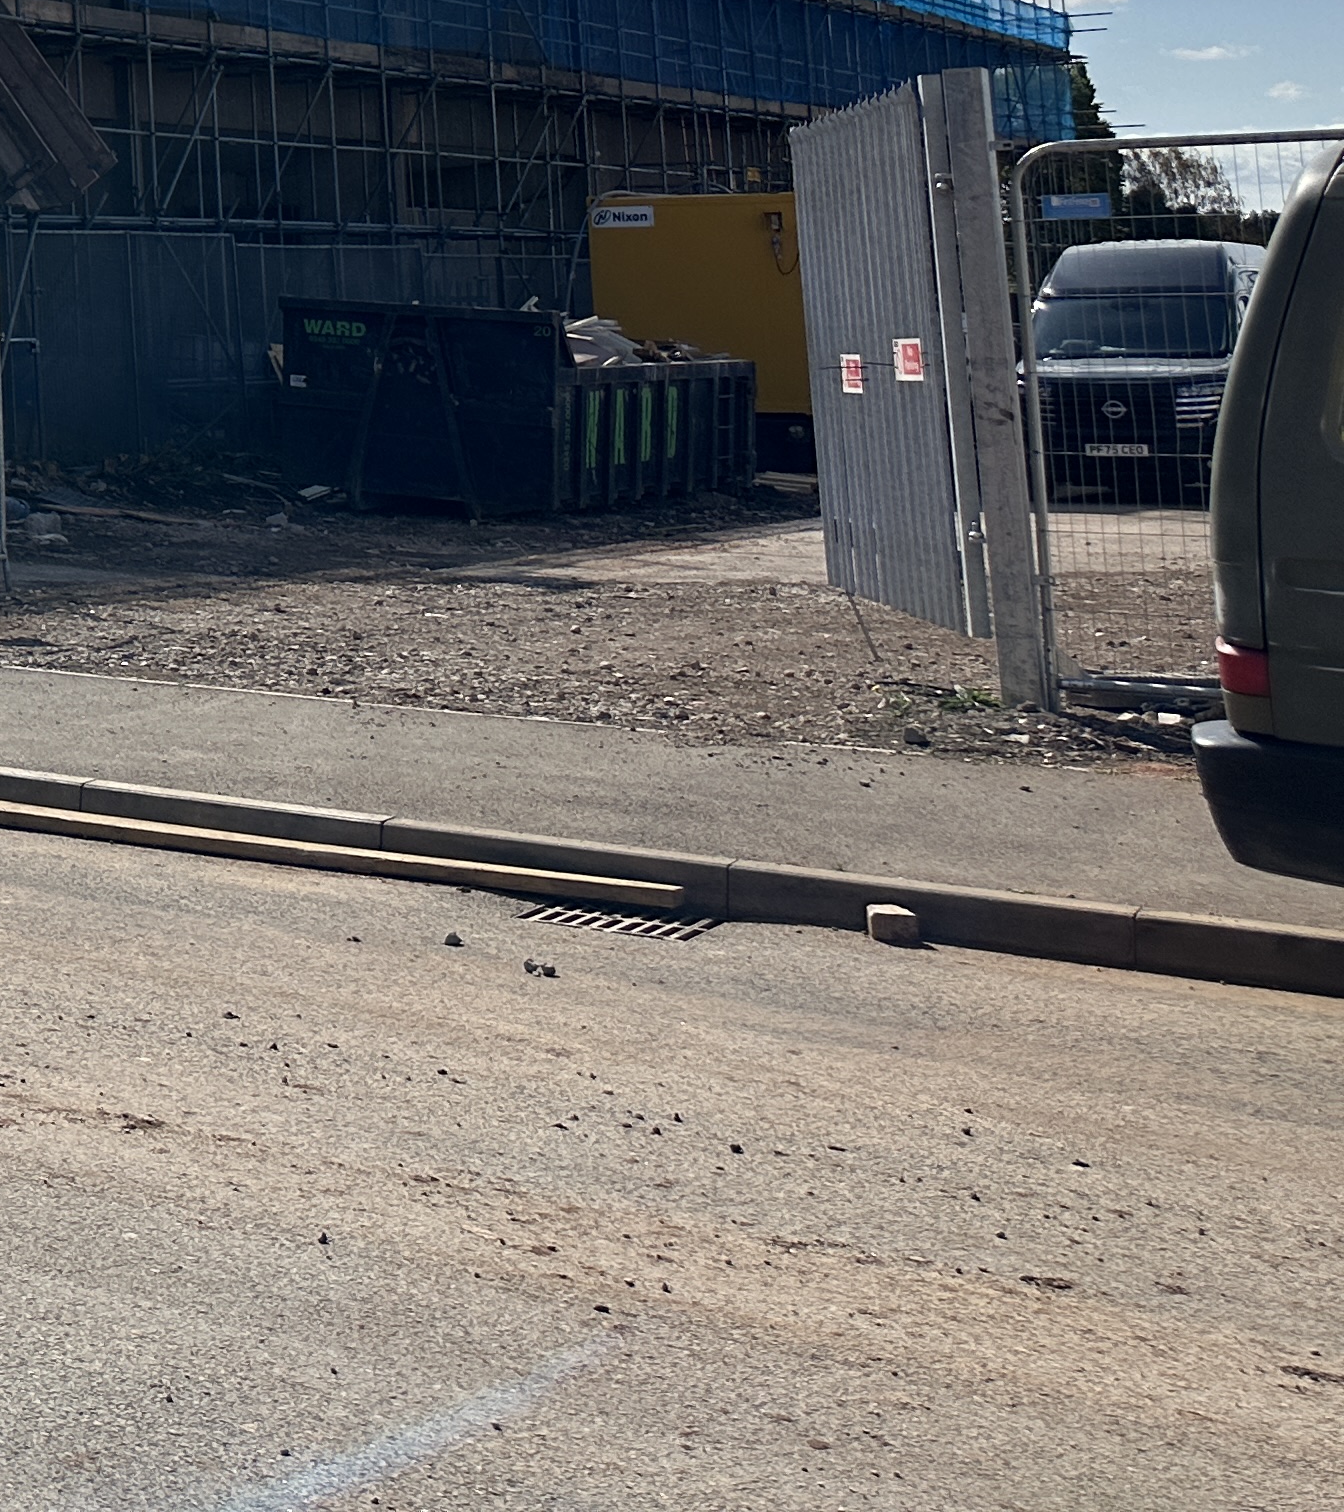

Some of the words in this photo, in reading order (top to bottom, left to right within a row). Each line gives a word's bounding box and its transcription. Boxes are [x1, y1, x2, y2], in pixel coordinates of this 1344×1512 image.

[612, 211, 648, 222] Nixon
[303, 318, 367, 337] WARD
[533, 325, 552, 338] 20
[1089, 445, 1119, 455] PF75
